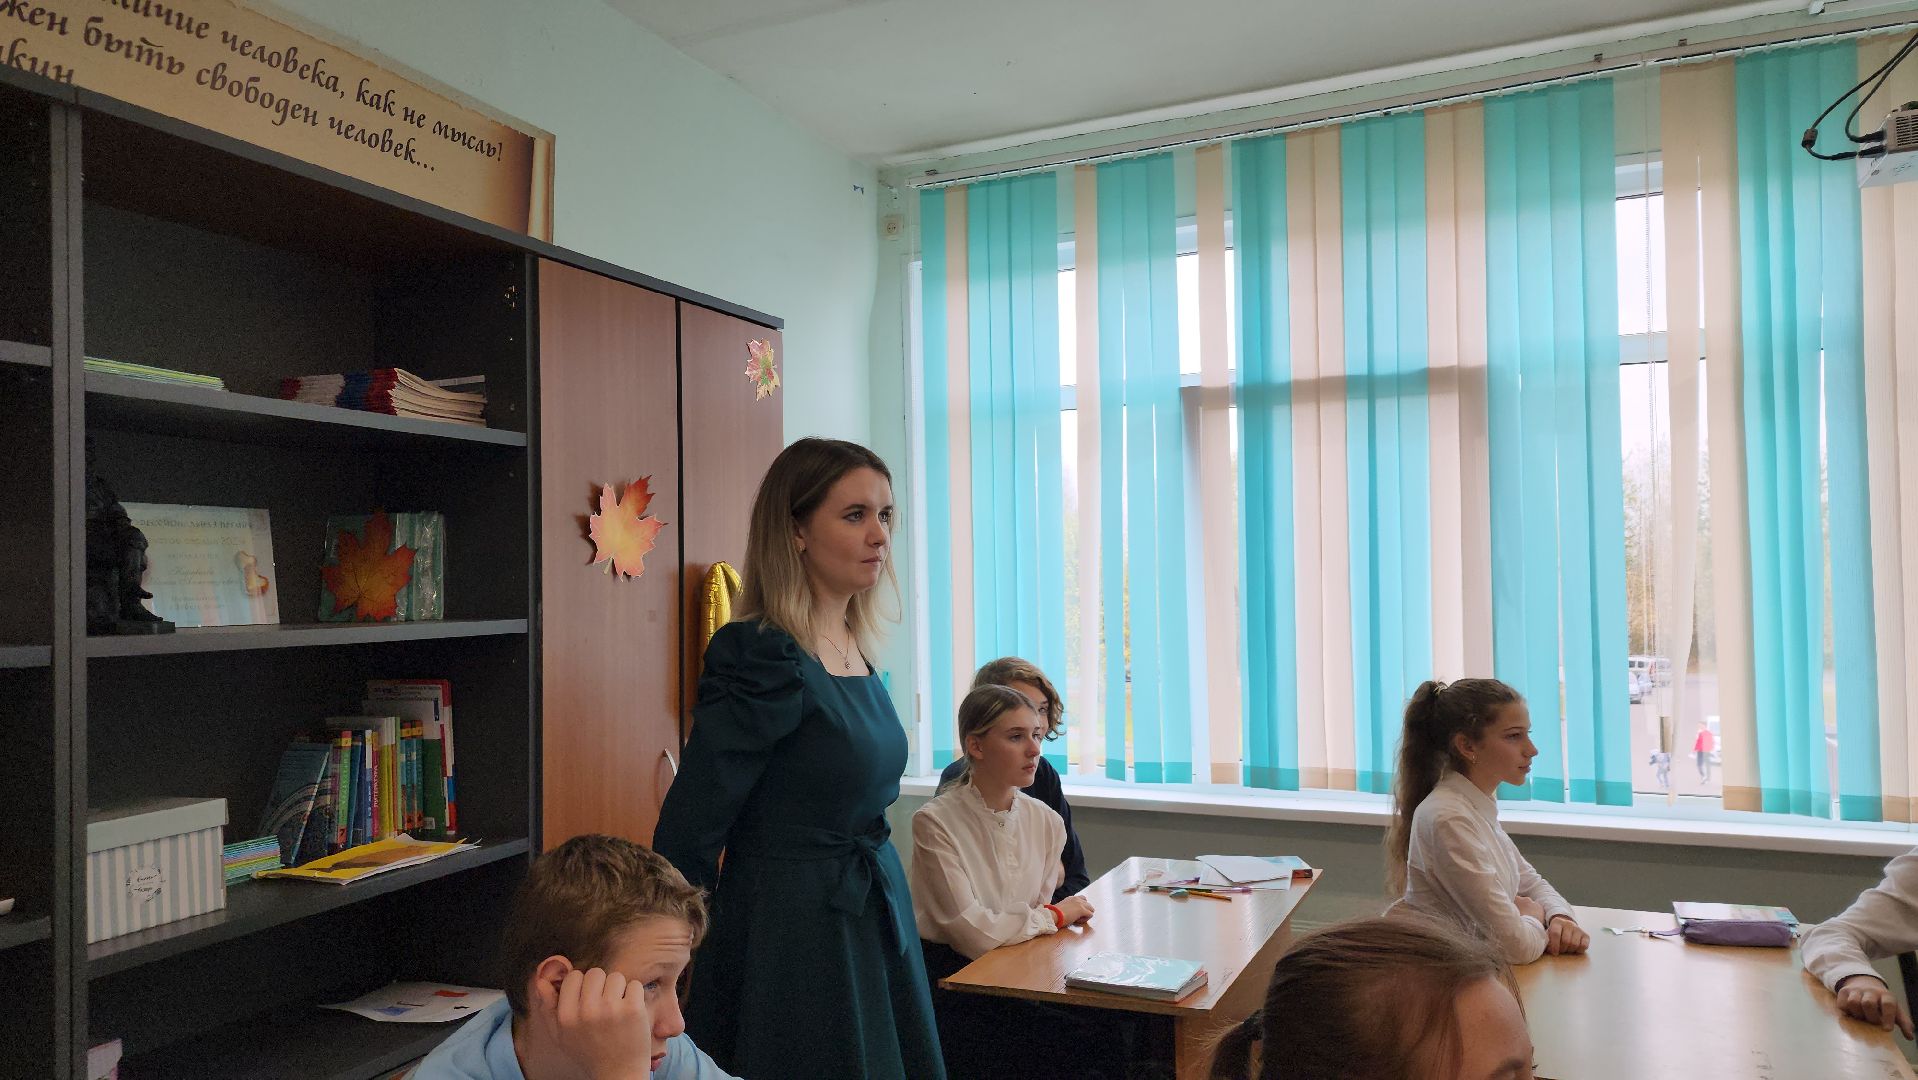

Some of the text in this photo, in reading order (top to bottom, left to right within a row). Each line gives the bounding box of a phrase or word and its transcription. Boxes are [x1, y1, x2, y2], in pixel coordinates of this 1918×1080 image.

[0, 38, 74, 84] кин
[83, 16, 185, 75] быть
[196, 62, 319, 126] свободен
[328, 116, 435, 172] человек...
[221, 30, 345, 99] человека,
[355, 77, 396, 117] как
[402, 106, 426, 128] не
[432, 120, 503, 162] мысль!
